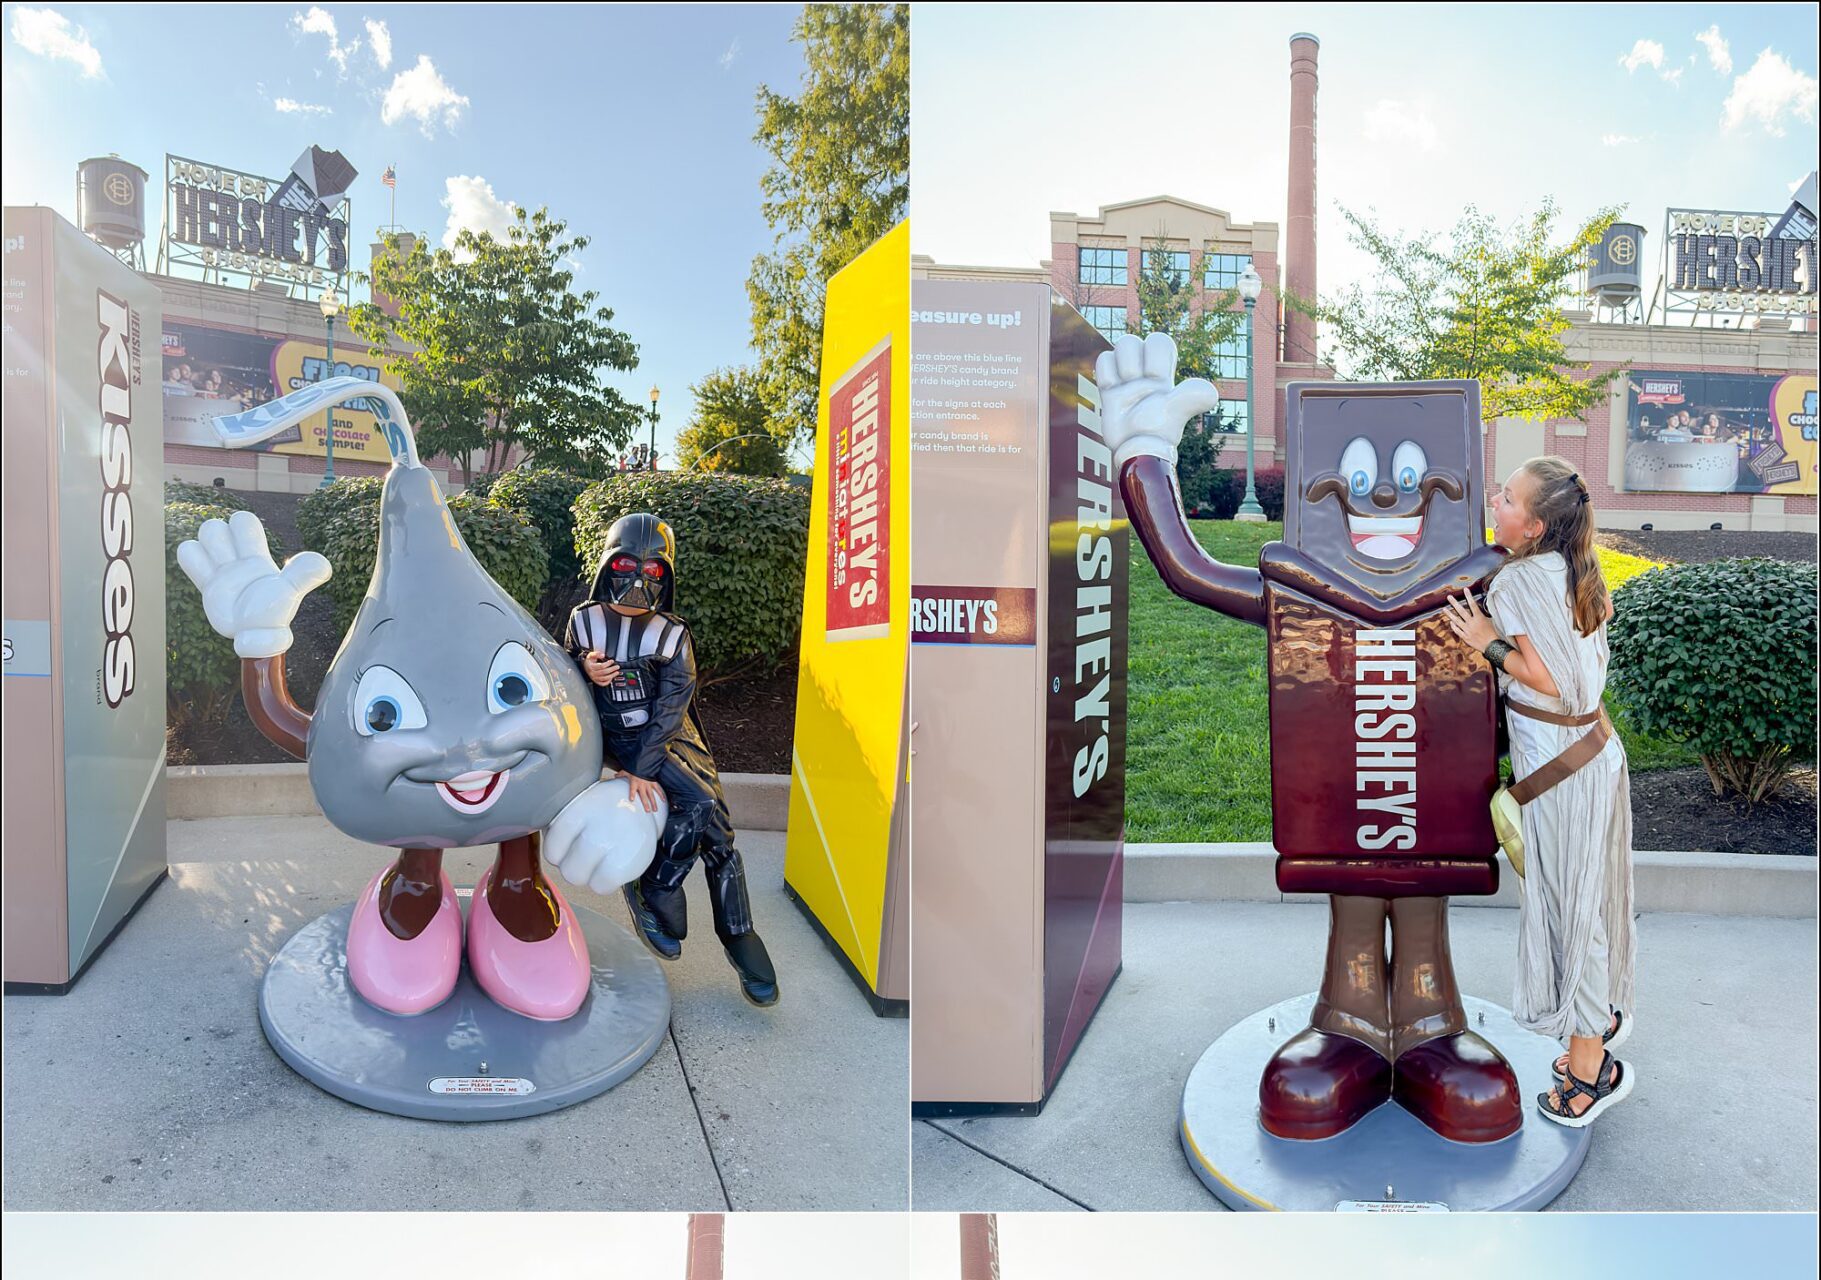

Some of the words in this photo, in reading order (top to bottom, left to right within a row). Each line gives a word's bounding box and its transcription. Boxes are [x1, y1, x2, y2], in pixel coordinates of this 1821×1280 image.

[174, 162, 235, 193] HOME
[240, 176, 267, 197] OF
[174, 184, 346, 270] HERSHEY'S
[1675, 214, 1735, 232] HOME
[1739, 217, 1767, 233] OF
[201, 247, 323, 283] CHOCOLATE
[1676, 234, 1817, 293] HERSHEY
[911, 310, 982, 325] easure
[987, 311, 1021, 329] up!
[934, 353, 961, 361] above
[964, 354, 981, 362] this
[983, 353, 1003, 362] blue
[1005, 354, 1022, 362] line
[960, 366, 988, 376] candy
[991, 366, 1018, 375] brand
[920, 377, 938, 385] ride
[940, 377, 970, 388] height
[972, 379, 1017, 389] category.
[912, 398, 925, 407] for
[928, 399, 942, 407] the
[945, 399, 969, 409] signs
[936, 412, 980, 420] entrance.
[920, 431, 948, 442] candy
[951, 431, 978, 440] brand
[981, 432, 989, 441] is
[933, 443, 954, 451] then
[956, 443, 976, 452] that
[978, 444, 996, 453] ride
[999, 445, 1006, 453] is
[1008, 445, 1022, 453] for
[838, 427, 851, 586] miniatures
[849, 378, 879, 609] HERSHEY'S
[1073, 373, 1114, 799] HERSHEY'S
[911, 598, 998, 634] RSHEY'S
[1355, 630, 1417, 850] HERSHEY'S
